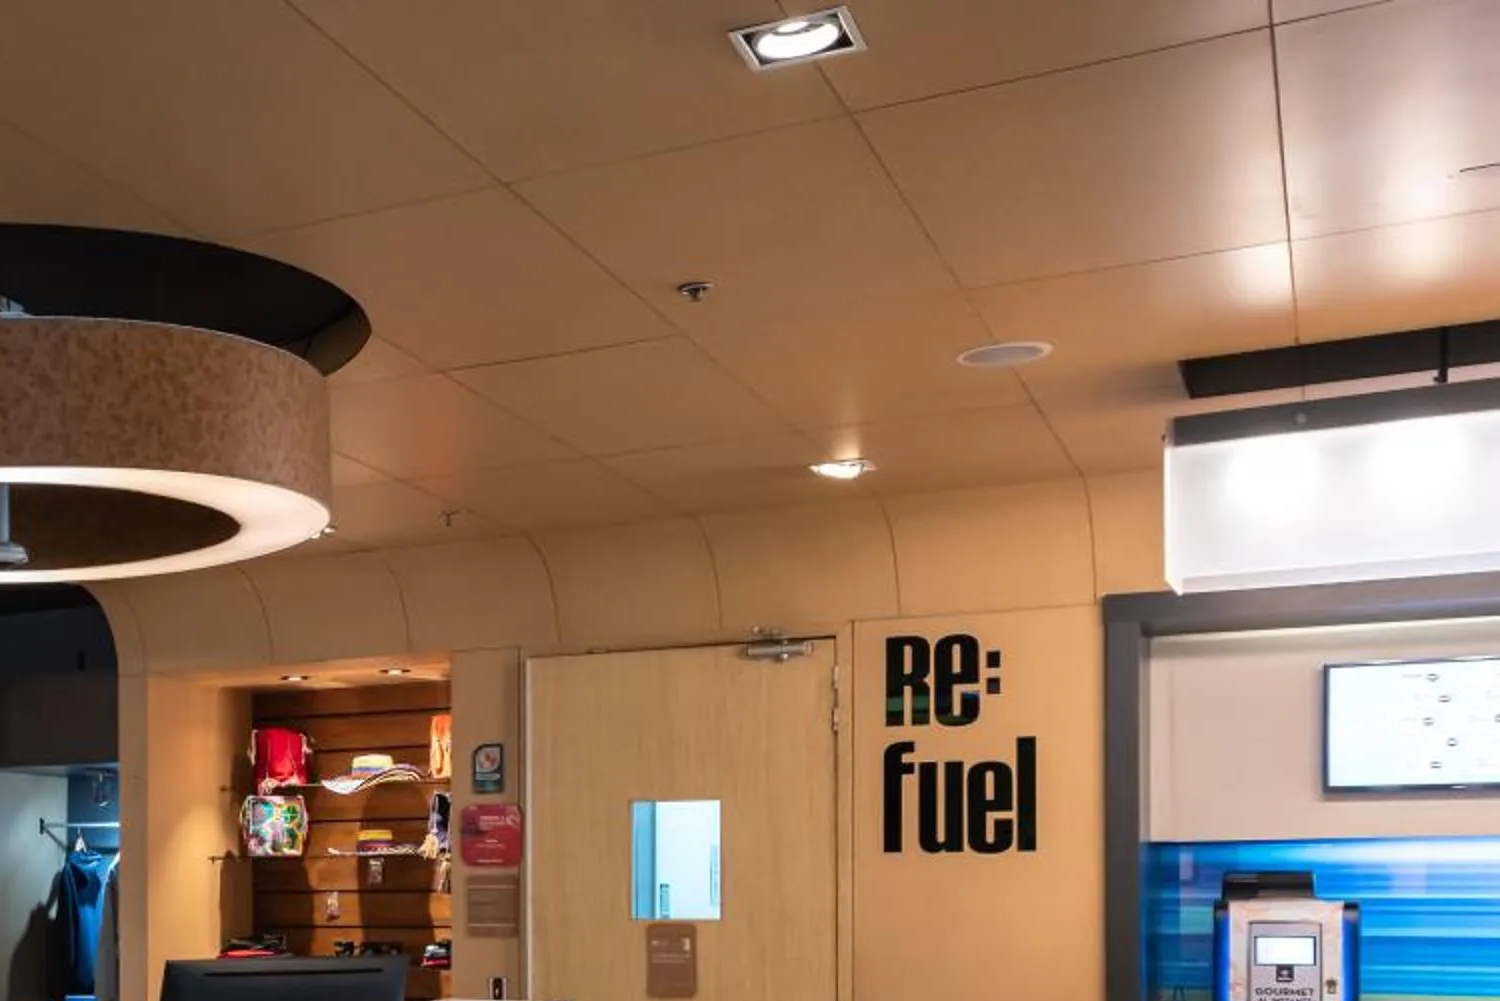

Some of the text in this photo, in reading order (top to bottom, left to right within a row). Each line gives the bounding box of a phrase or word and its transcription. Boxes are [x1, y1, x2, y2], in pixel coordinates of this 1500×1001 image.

[885, 633, 1000, 727] Re:
[883, 736, 1037, 854] fuel
[1255, 987, 1315, 997] GOURMET
